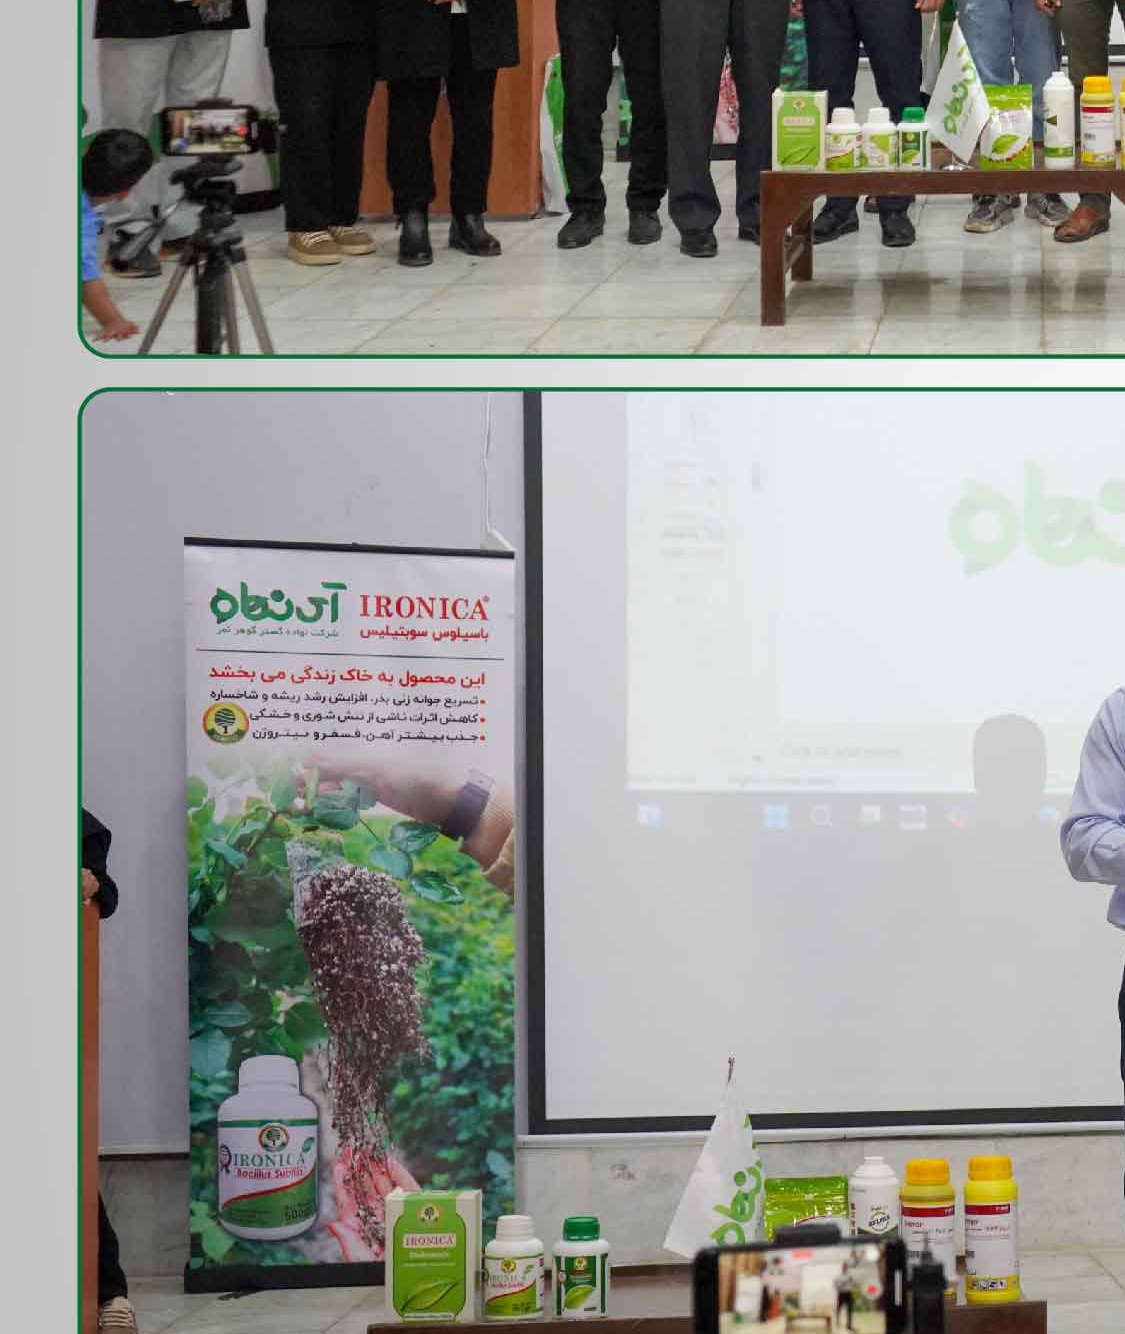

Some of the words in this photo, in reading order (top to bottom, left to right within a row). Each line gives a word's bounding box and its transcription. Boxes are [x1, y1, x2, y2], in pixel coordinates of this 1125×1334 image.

[359, 594, 489, 621] IRONICA
[432, 626, 489, 642] باسیلوس
[208, 664, 257, 683] بخشد
[260, 669, 286, 683] می
[290, 665, 336, 685] زندگی
[340, 667, 373, 682] خاک
[378, 671, 394, 687] به
[398, 669, 457, 687] محصول
[460, 671, 485, 689] این
[261, 692, 268, 702] و
[271, 691, 301, 703] ریشه
[304, 691, 327, 704] رشد
[249, 708, 292, 721] خشکی
